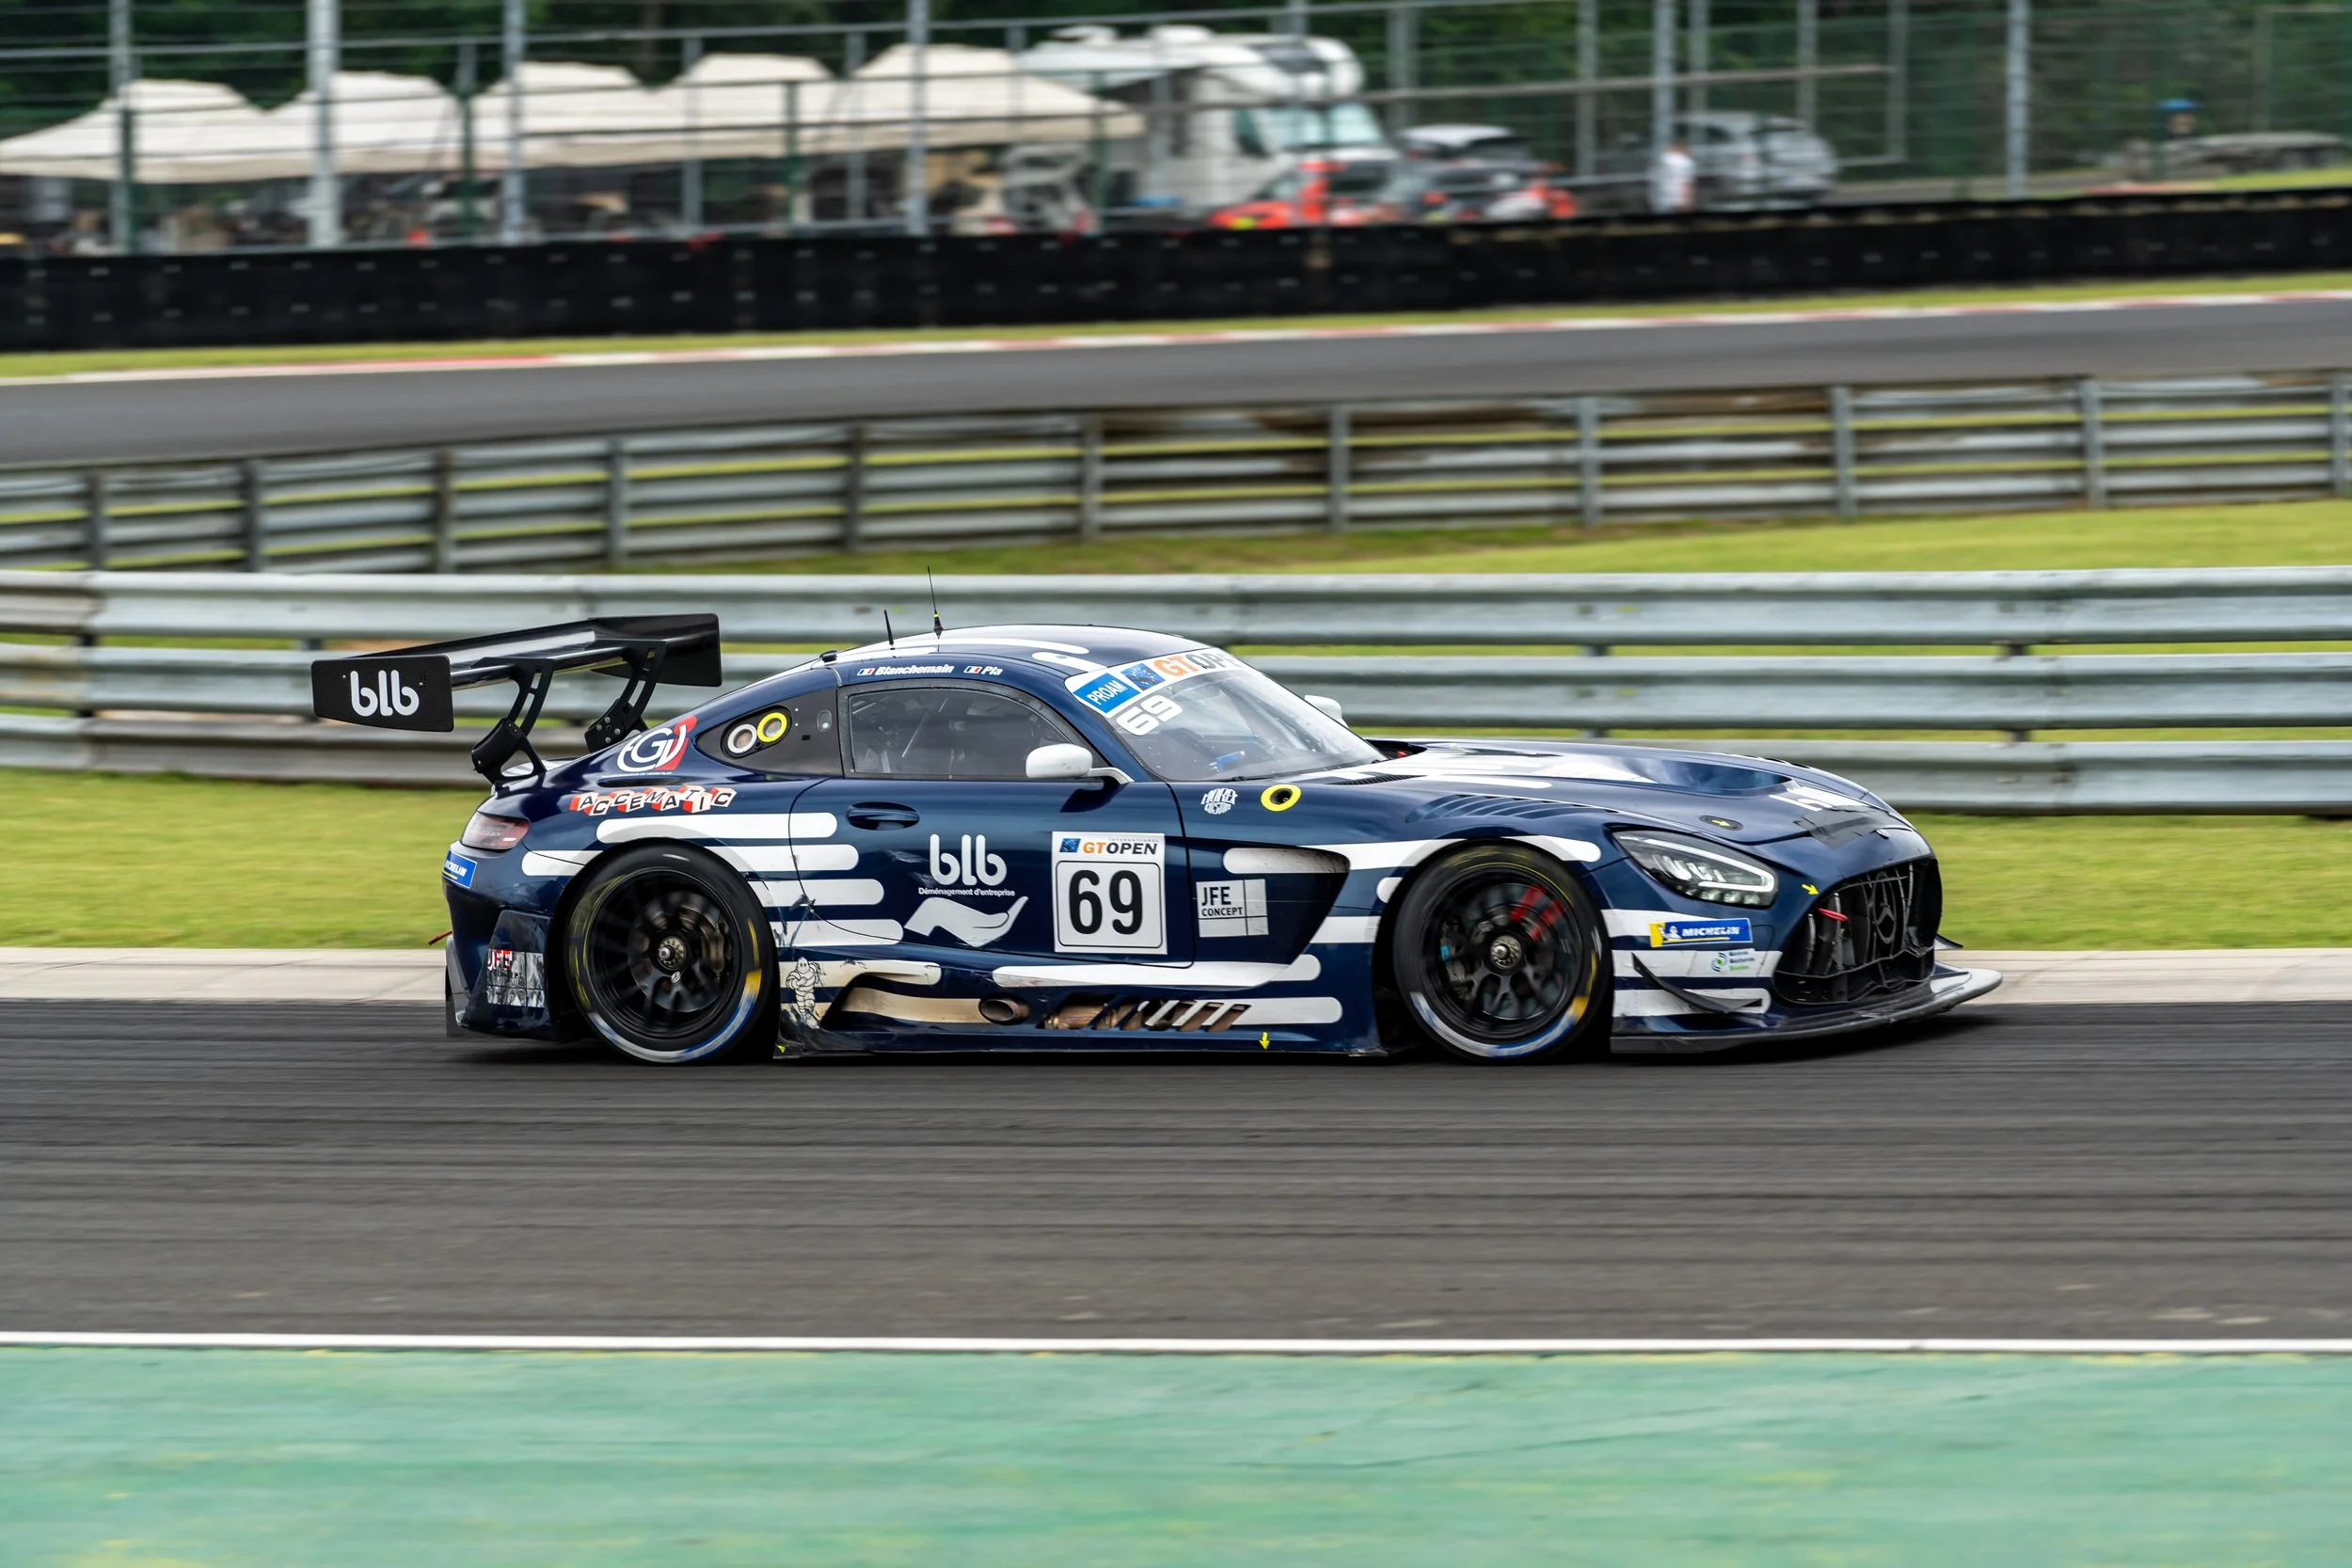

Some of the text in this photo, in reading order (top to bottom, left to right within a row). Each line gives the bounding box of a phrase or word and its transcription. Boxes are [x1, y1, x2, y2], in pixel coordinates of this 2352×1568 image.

[875, 664, 1004, 676] Blanchemain Pla
[350, 670, 420, 717] blb
[1086, 679, 1128, 705] PROAM
[1116, 695, 1183, 736] 69
[577, 788, 733, 816] ACCEMATIC
[930, 833, 1008, 886] blb
[918, 887, 1016, 896] Déménagement d'entreprise
[1069, 869, 1143, 935] 69
[1201, 886, 1232, 906] JFE
[1201, 907, 1244, 917] CONCEPT
[1682, 926, 1740, 937] MICHELIN
